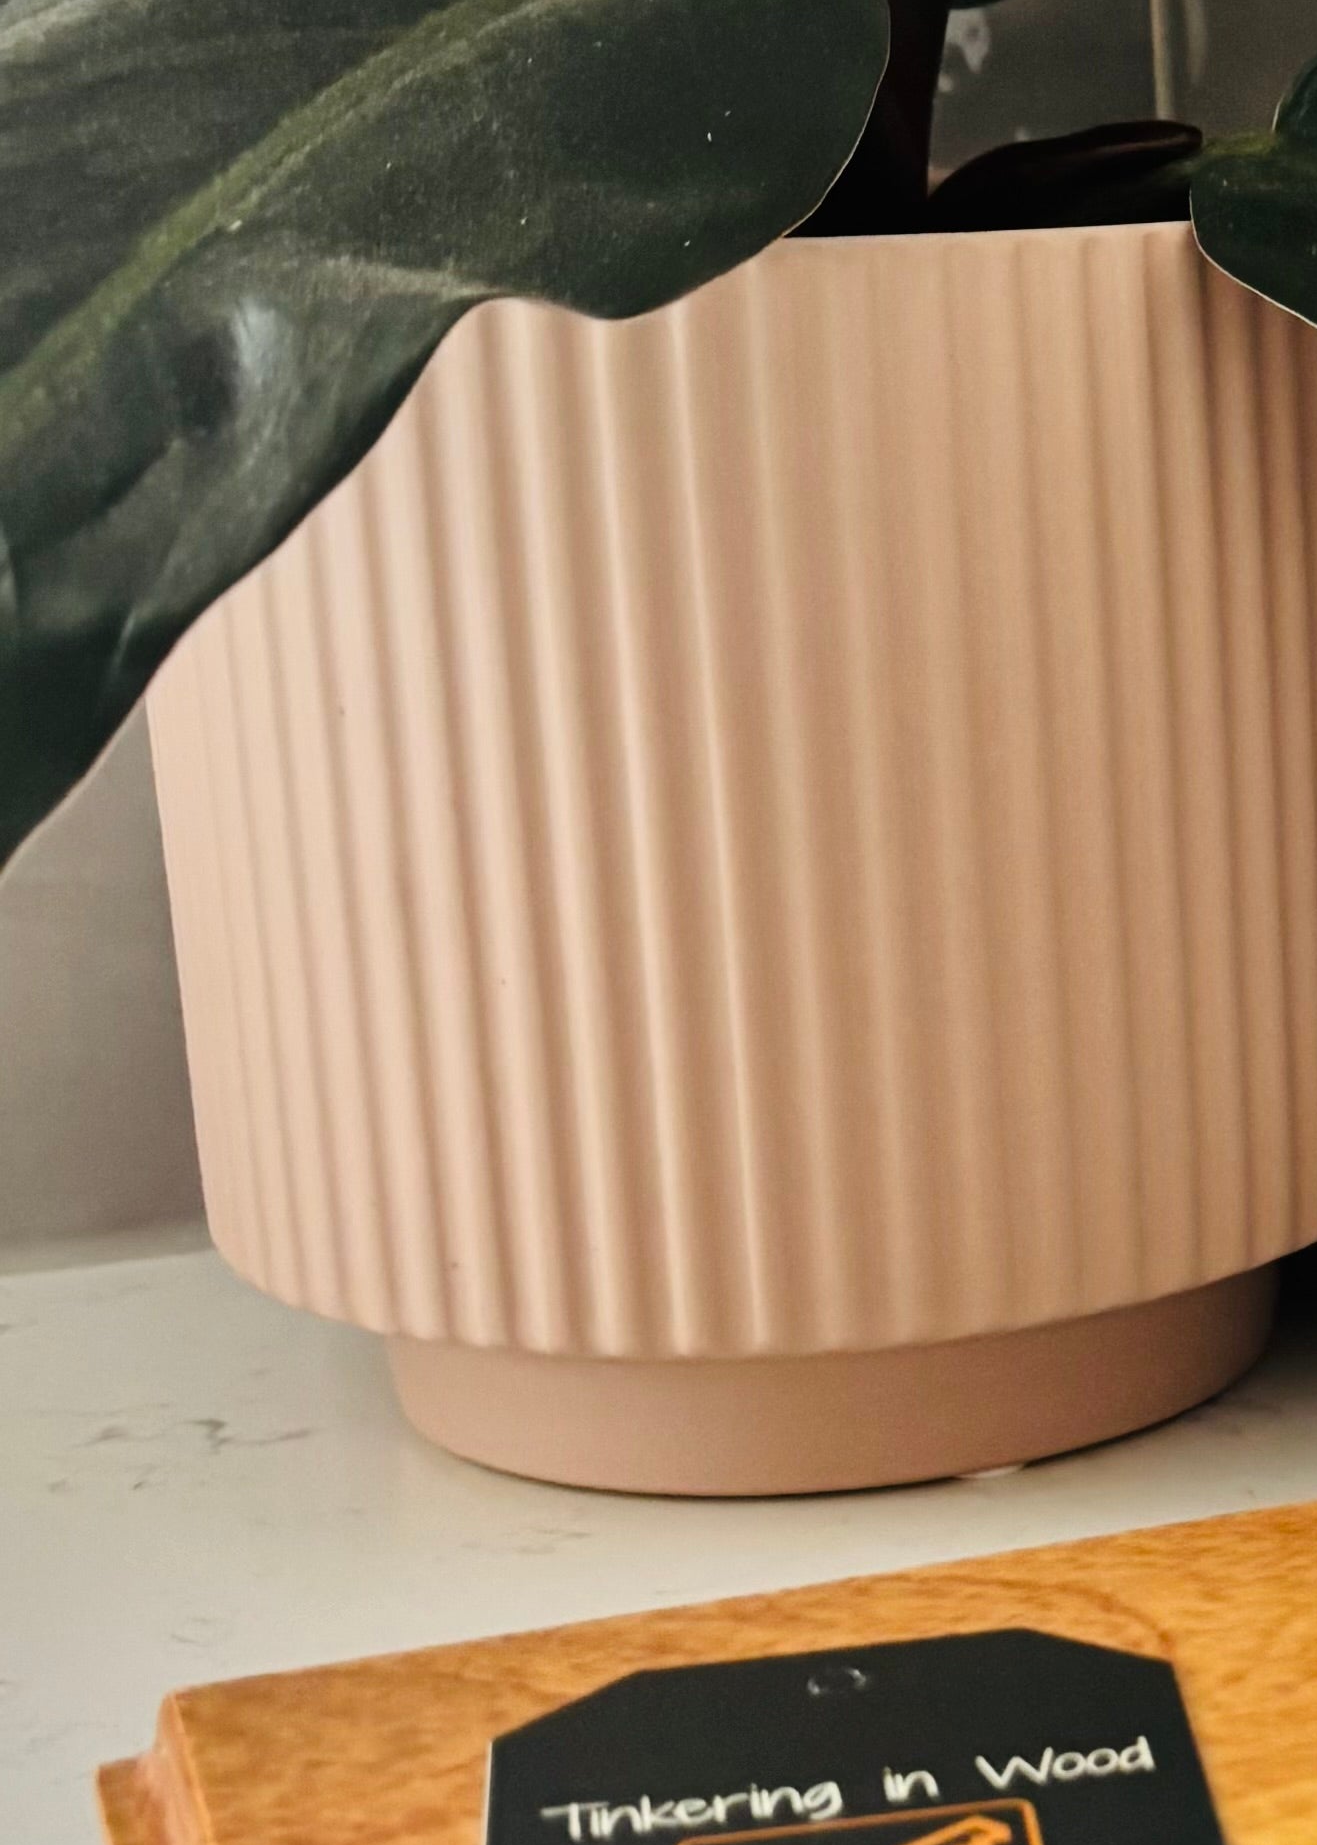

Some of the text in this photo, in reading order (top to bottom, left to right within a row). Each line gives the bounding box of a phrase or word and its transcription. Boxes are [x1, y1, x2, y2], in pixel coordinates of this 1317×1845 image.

[540, 1734, 1157, 1842] Tinkering in Wood
